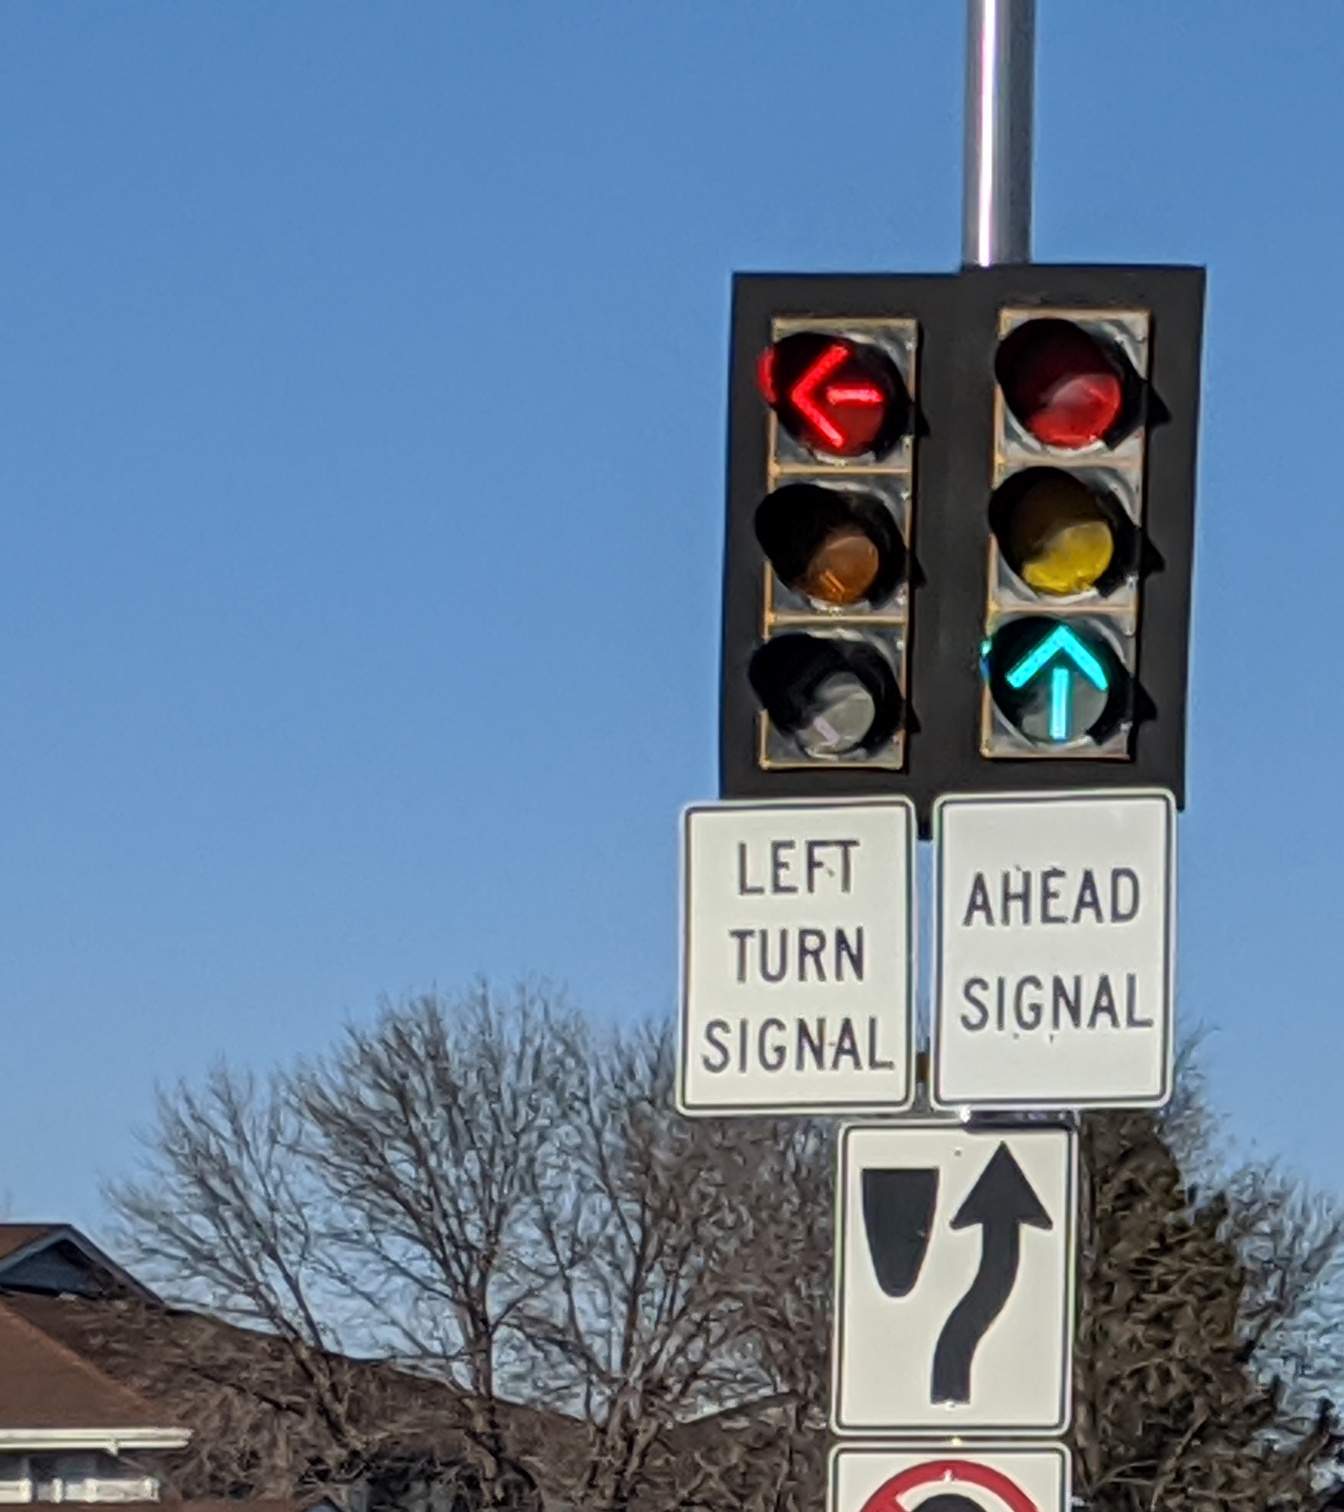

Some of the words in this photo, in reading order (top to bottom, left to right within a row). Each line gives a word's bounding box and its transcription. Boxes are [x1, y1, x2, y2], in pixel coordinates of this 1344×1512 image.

[738, 840, 860, 896] LEFT
[962, 867, 1141, 927] AHEAD
[729, 926, 864, 983] TURN
[960, 973, 1155, 1032] SIGNAL
[701, 1016, 894, 1073] SIGNAL
